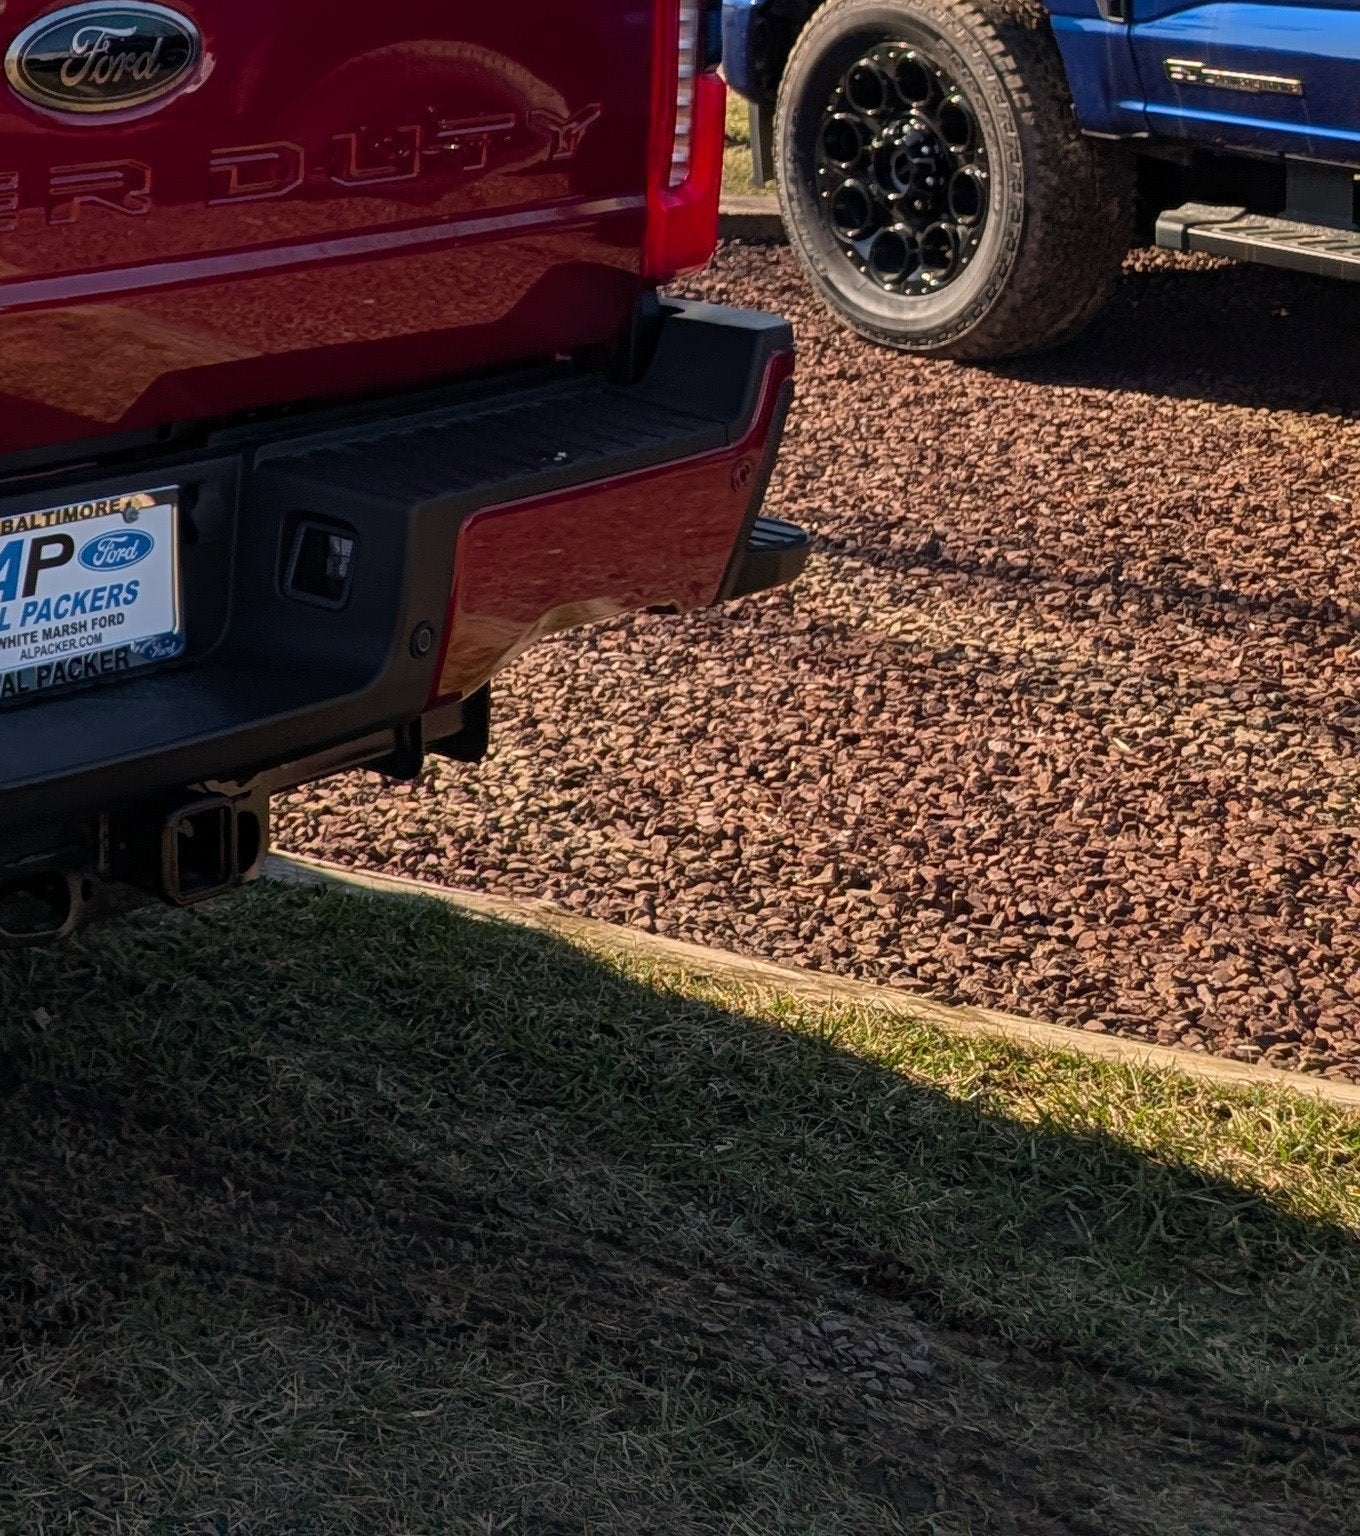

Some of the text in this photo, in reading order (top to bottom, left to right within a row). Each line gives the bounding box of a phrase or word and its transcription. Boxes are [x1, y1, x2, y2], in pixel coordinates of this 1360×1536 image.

[60, 24, 163, 88] Ford
[207, 101, 602, 207] DUTY
[0, 497, 121, 536] BALTIMORE
[19, 579, 140, 628] PACKERS
[41, 622, 89, 642] MARSH
[91, 612, 126, 633] FORD
[19, 632, 104, 661] ALPACKER.COM
[0, 670, 30, 698] AL
[36, 647, 130, 689] PACKER
